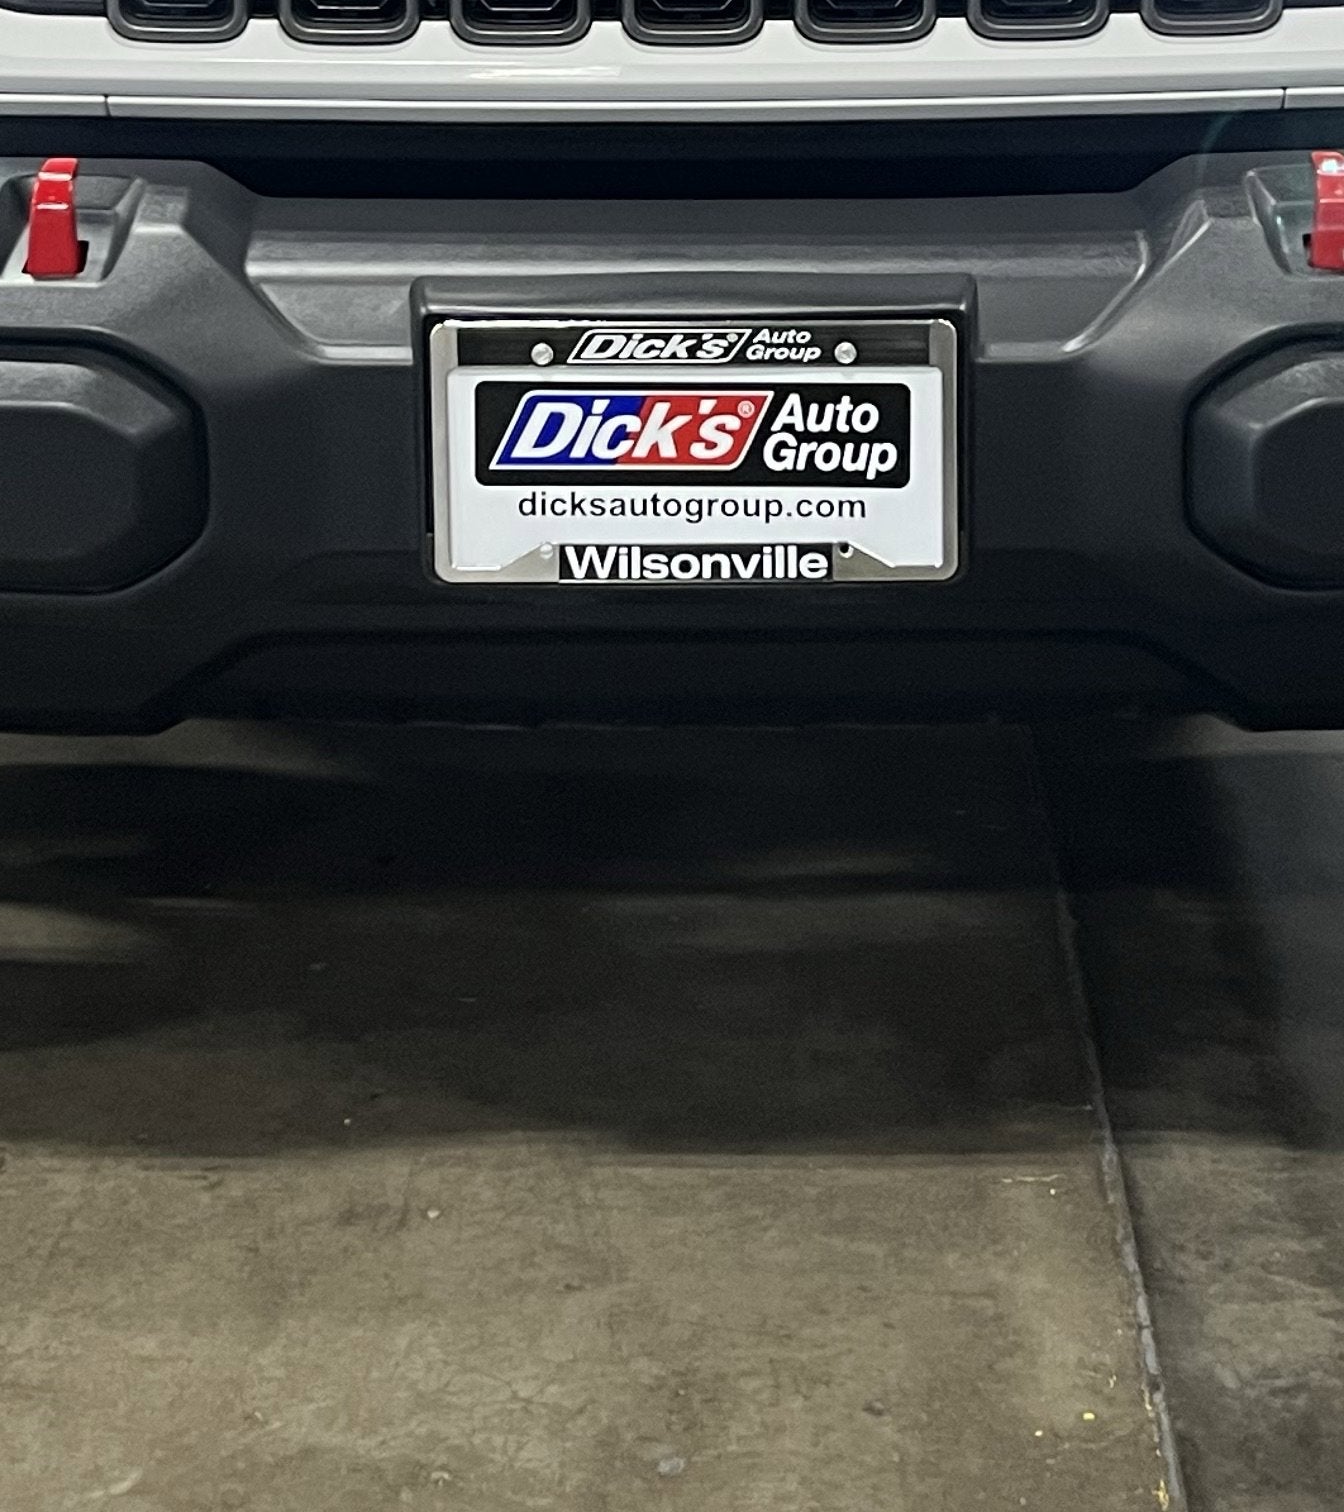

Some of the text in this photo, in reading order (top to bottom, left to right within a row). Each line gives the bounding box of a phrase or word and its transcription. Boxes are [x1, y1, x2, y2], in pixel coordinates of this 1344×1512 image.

[746, 344, 822, 363] Group
[752, 328, 812, 344] Auto
[509, 399, 742, 460] Dick's
[770, 393, 880, 433] Auto
[762, 431, 898, 480] Group
[517, 491, 867, 524] dicksautogroup.com
[564, 544, 829, 580] Wilsonville
